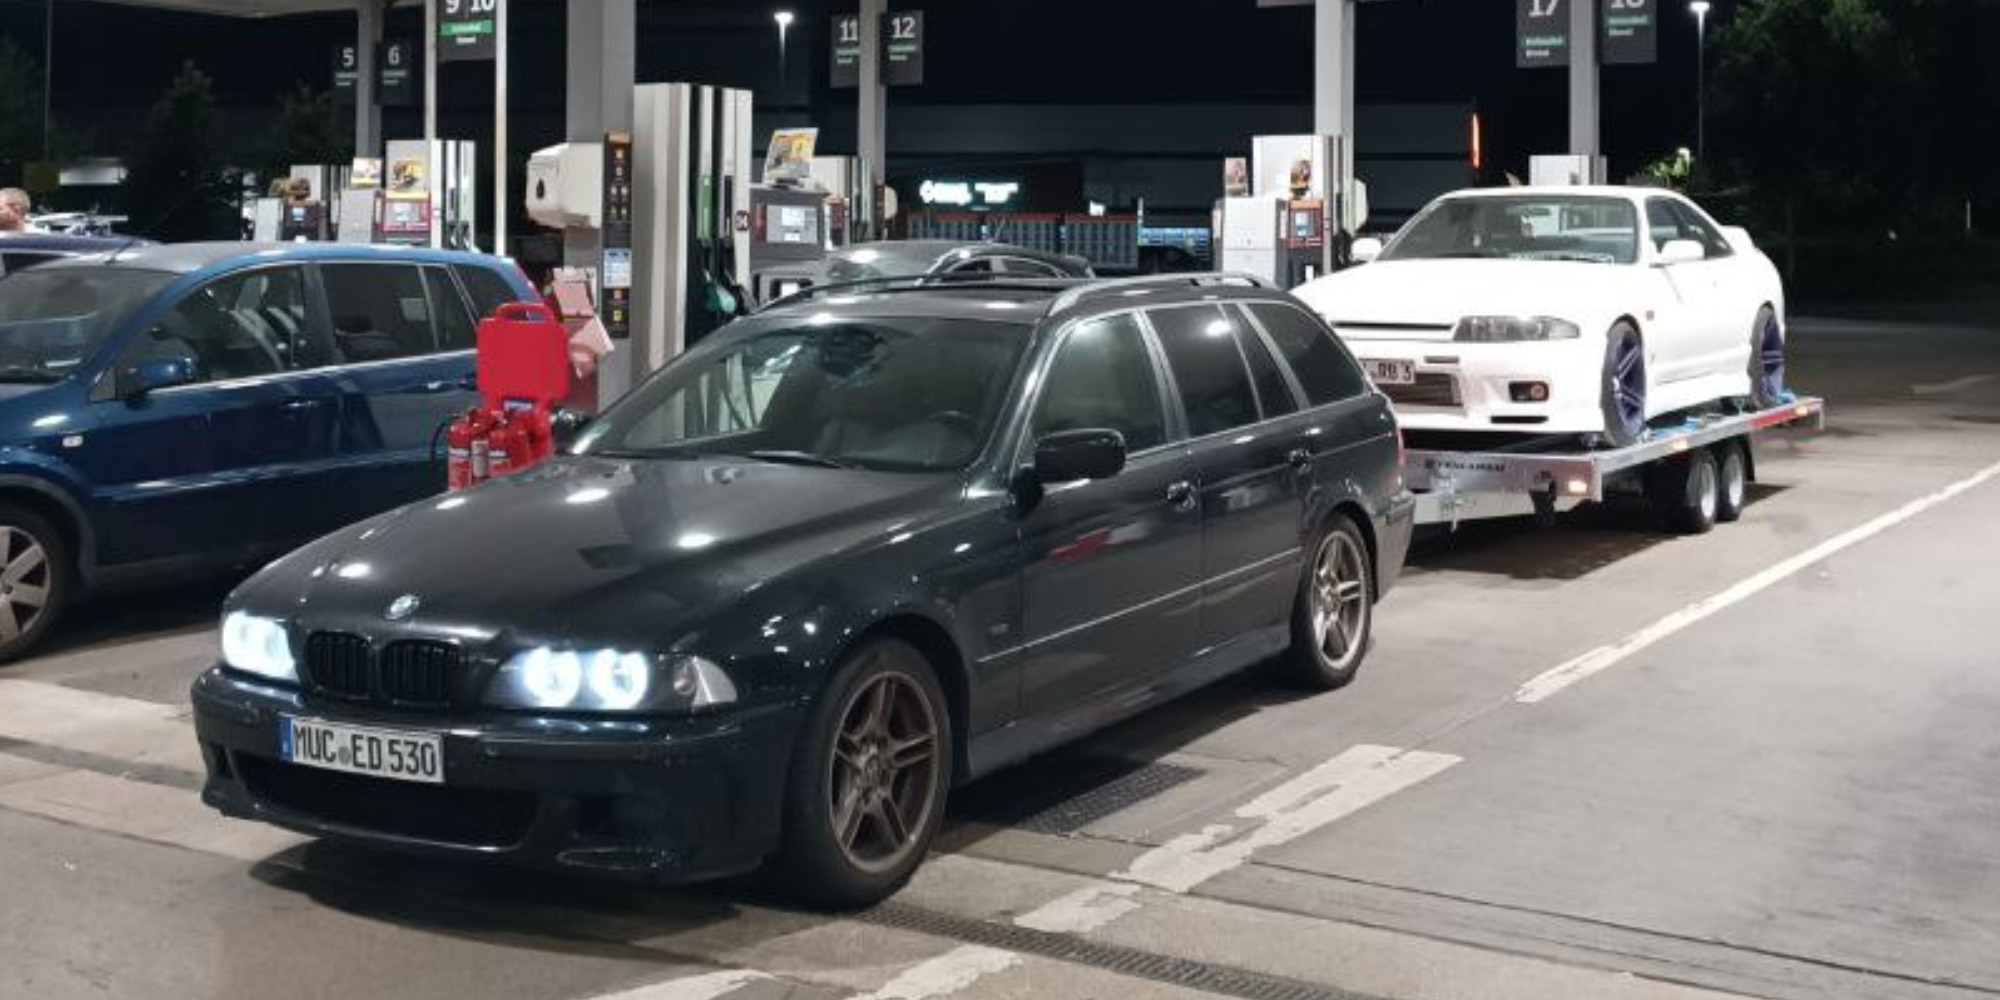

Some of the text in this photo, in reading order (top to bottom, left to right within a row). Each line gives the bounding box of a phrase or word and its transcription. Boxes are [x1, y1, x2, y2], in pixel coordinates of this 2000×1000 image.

[839, 18, 859, 42] 11
[892, 16, 916, 39] 12
[342, 46, 355, 69] 5
[387, 45, 401, 67] 6
[293, 724, 437, 777] MUC ED 530
